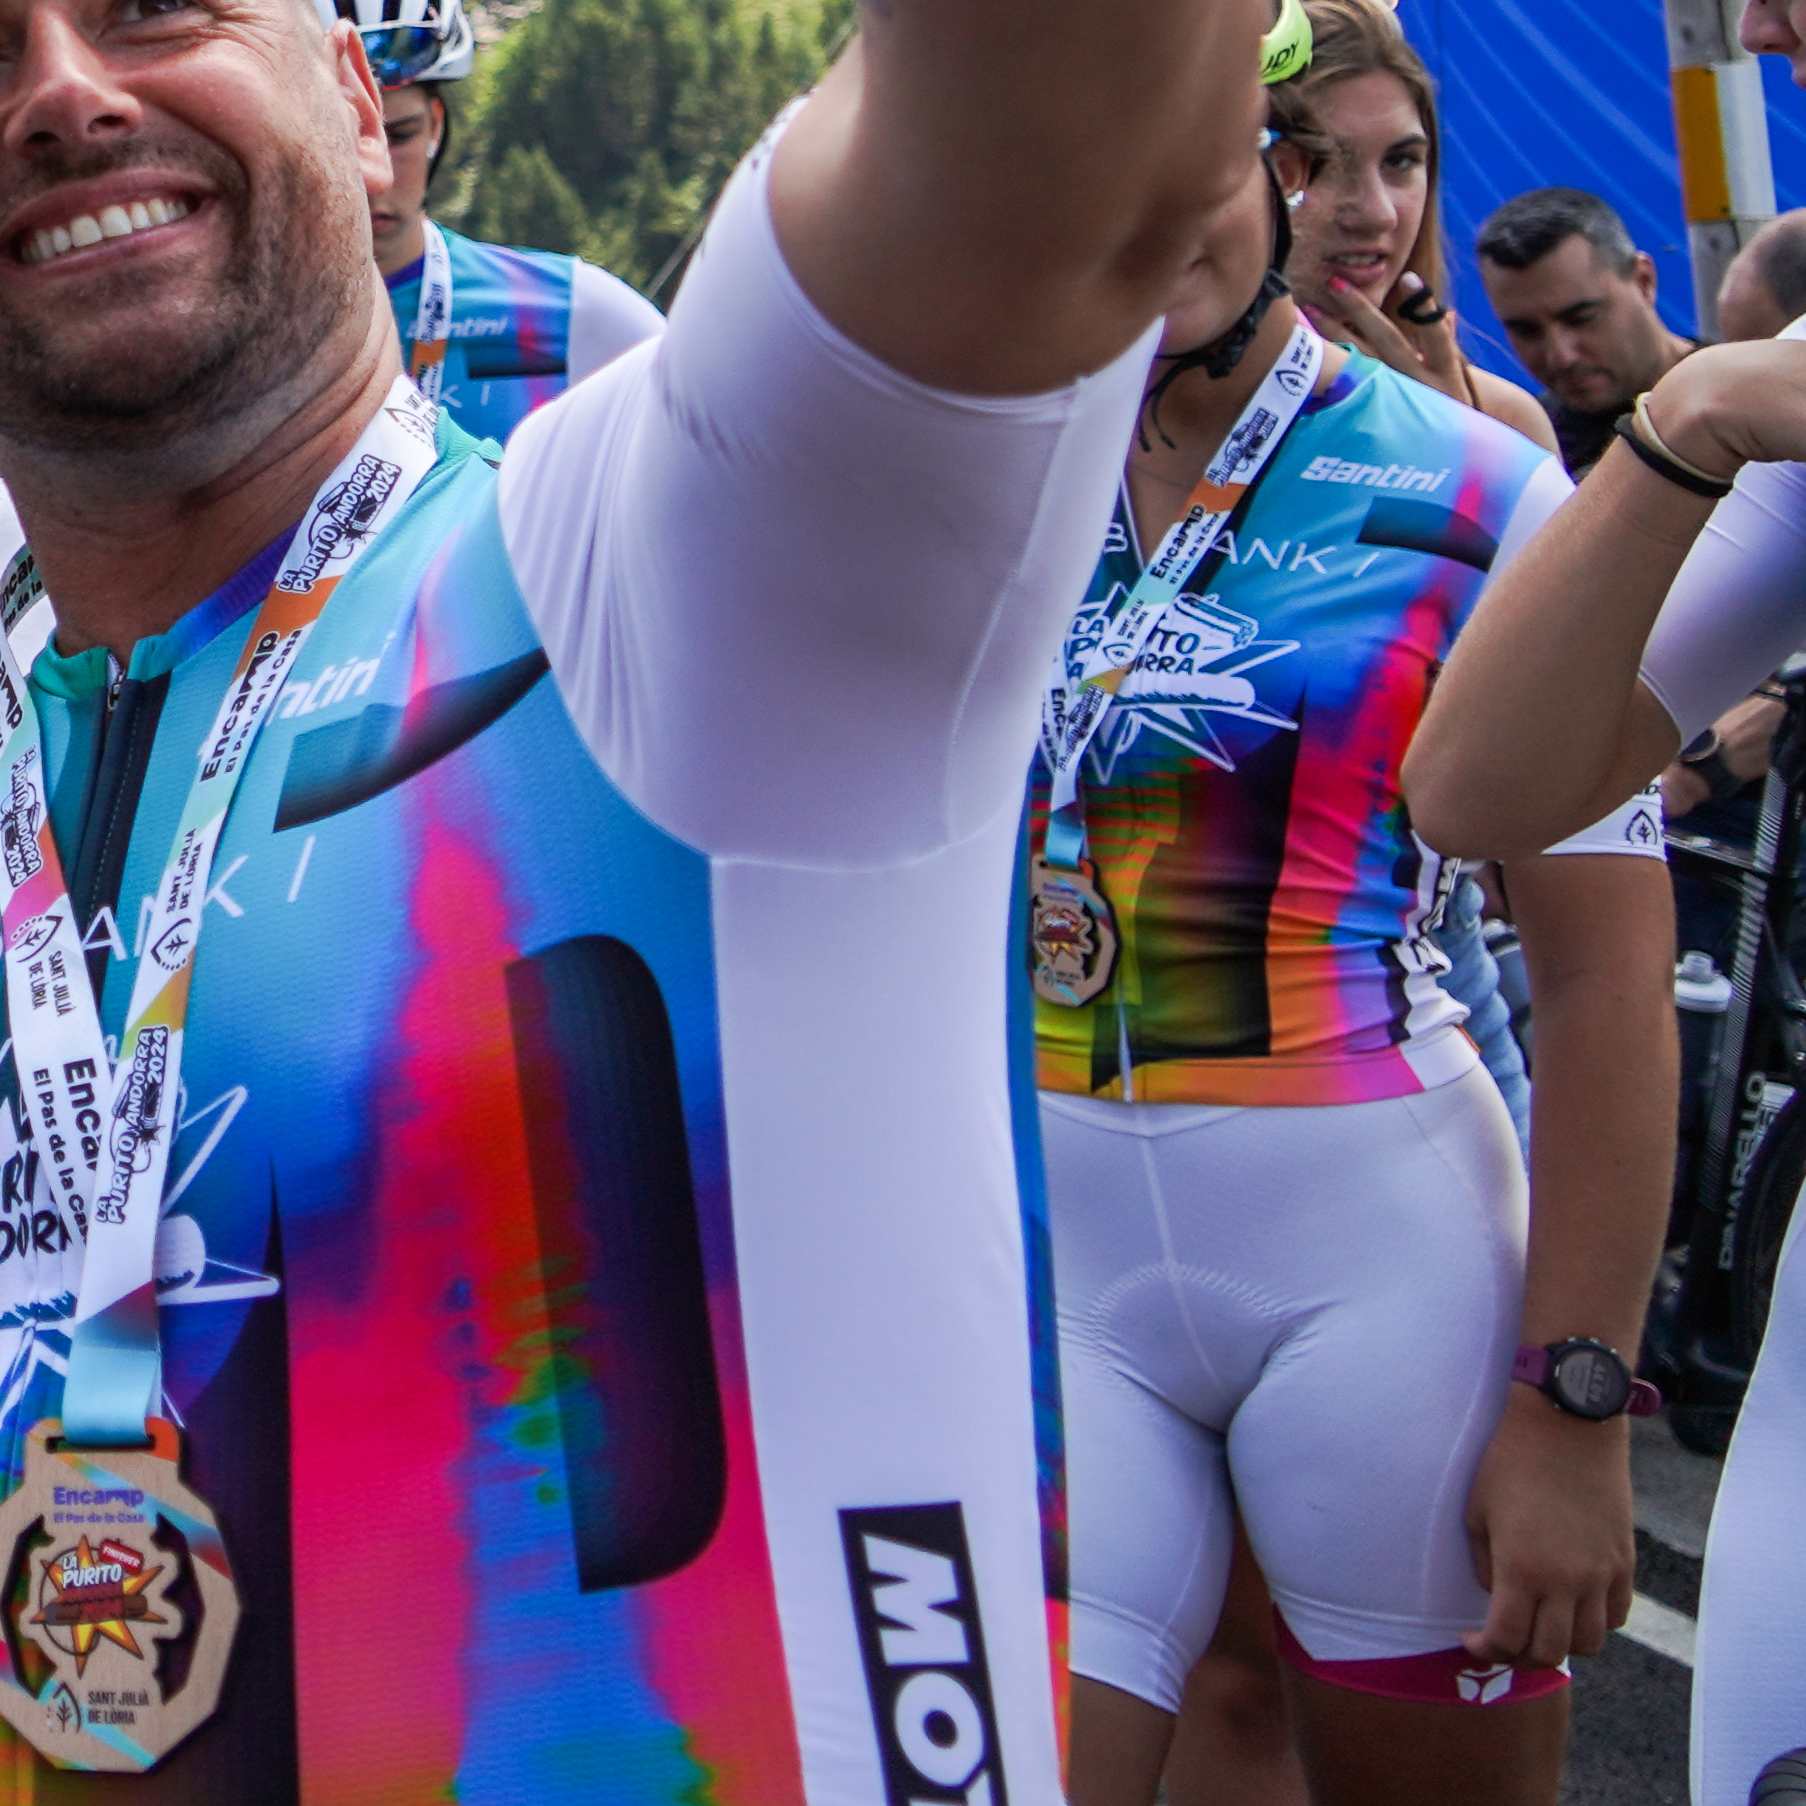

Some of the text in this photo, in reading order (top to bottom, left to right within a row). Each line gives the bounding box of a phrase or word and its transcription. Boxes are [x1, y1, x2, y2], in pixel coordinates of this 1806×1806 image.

[366, 461, 402, 501] 2024
[1300, 455, 1451, 492] Santini
[293, 454, 382, 593] PURITO ANDORRA
[1150, 504, 1206, 579] Encamp
[277, 570, 297, 592] LA
[273, 631, 397, 721] ntini
[200, 632, 279, 782] Encamp
[224, 630, 302, 773] El Pas de la Casa
[11, 753, 42, 874] PURITO ANDORRA
[6, 843, 28, 888] 2024
[166, 875, 183, 913] SANT
[179, 889, 191, 910] DE
[28, 961, 44, 979] DE
[49, 950, 66, 982] SANT
[146, 1026, 168, 1084] 2024
[63, 1058, 102, 1172] Enca
[106, 1029, 153, 1225] PURITO ANDORRA
[33, 1068, 88, 1244] El Pas de la Ca
[95, 1196, 110, 1223] LA
[53, 1486, 145, 1508] Encamp
[66, 1513, 85, 1524] Pas
[118, 1513, 146, 1524] Casa
[62, 1556, 78, 1570] LA
[62, 1564, 123, 1589] PURITO
[88, 1690, 116, 1705] SANT
[88, 1710, 102, 1724] DE
